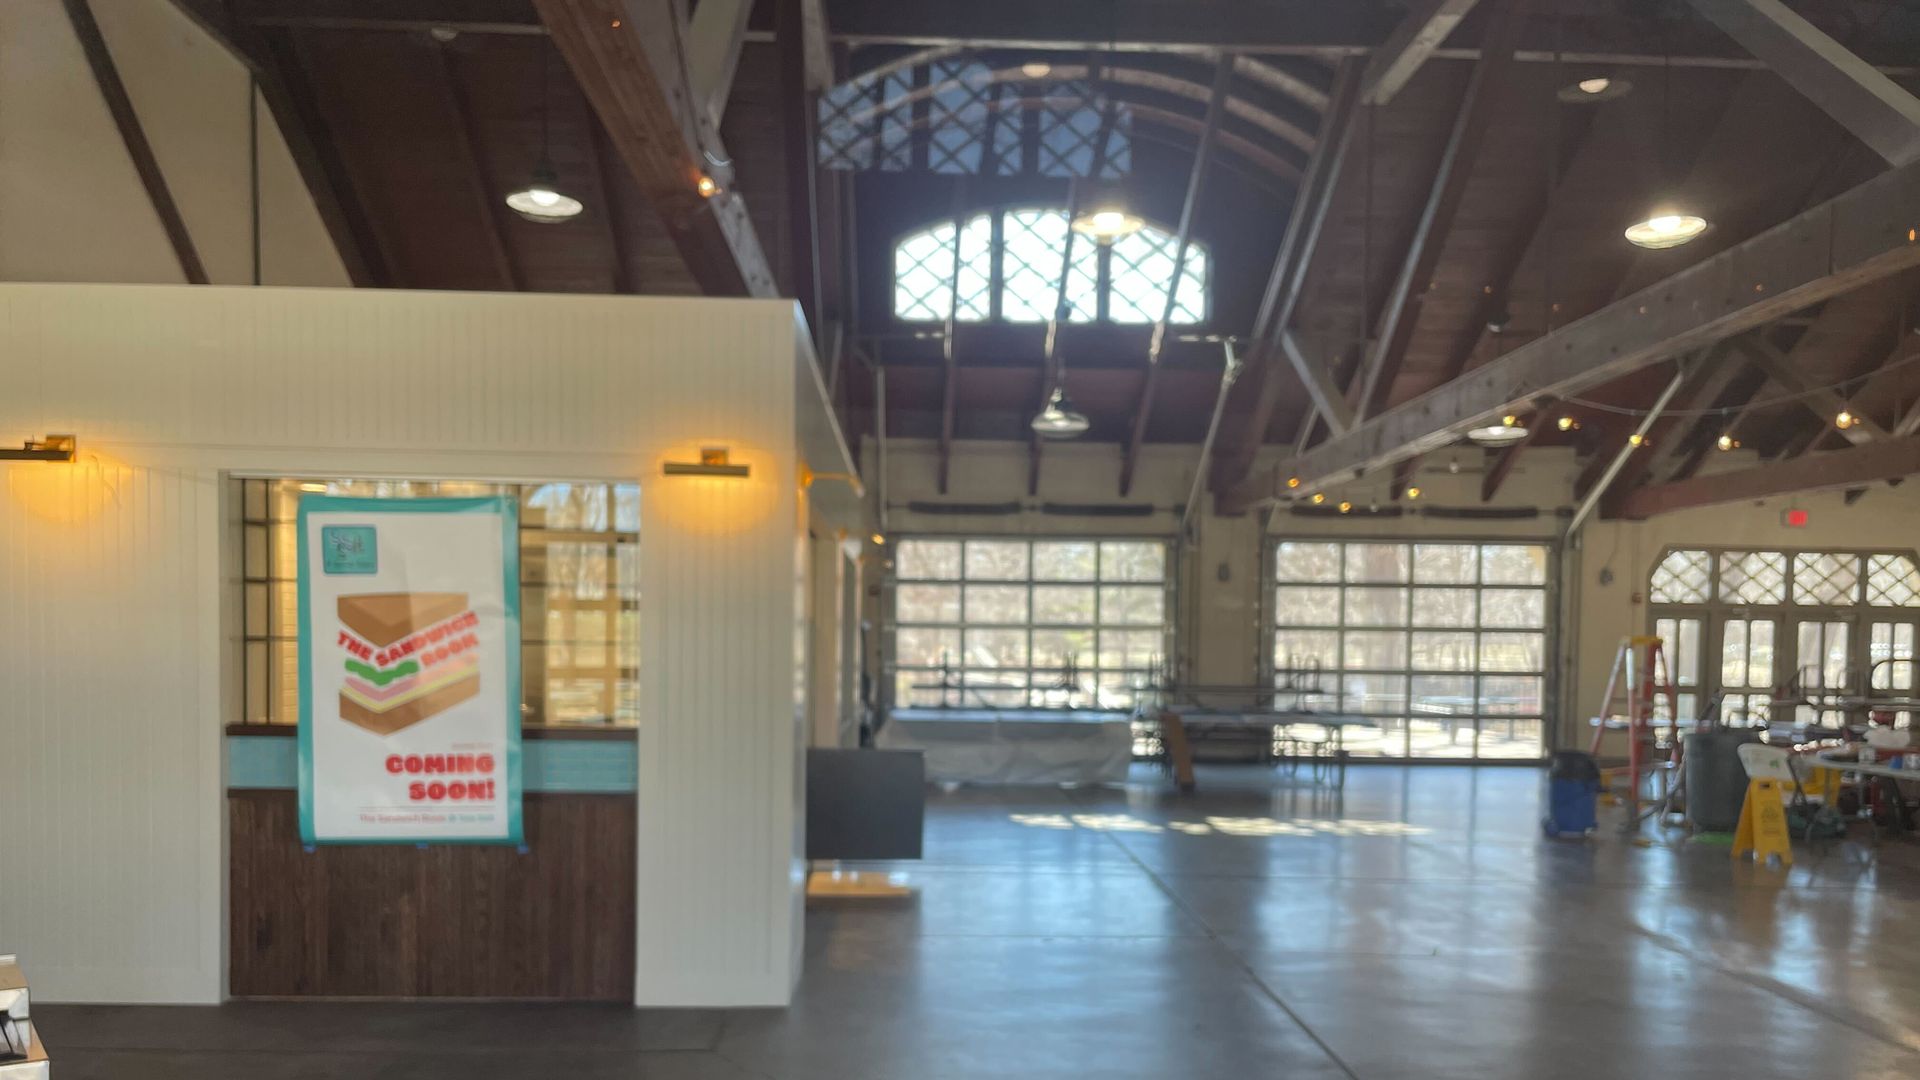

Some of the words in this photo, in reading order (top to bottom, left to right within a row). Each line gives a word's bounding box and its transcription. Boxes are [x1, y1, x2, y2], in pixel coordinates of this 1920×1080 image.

[337, 630, 372, 660] THE
[375, 611, 479, 667] SANDWICH
[385, 753, 495, 774] COMING
[408, 779, 495, 802] SOON!
